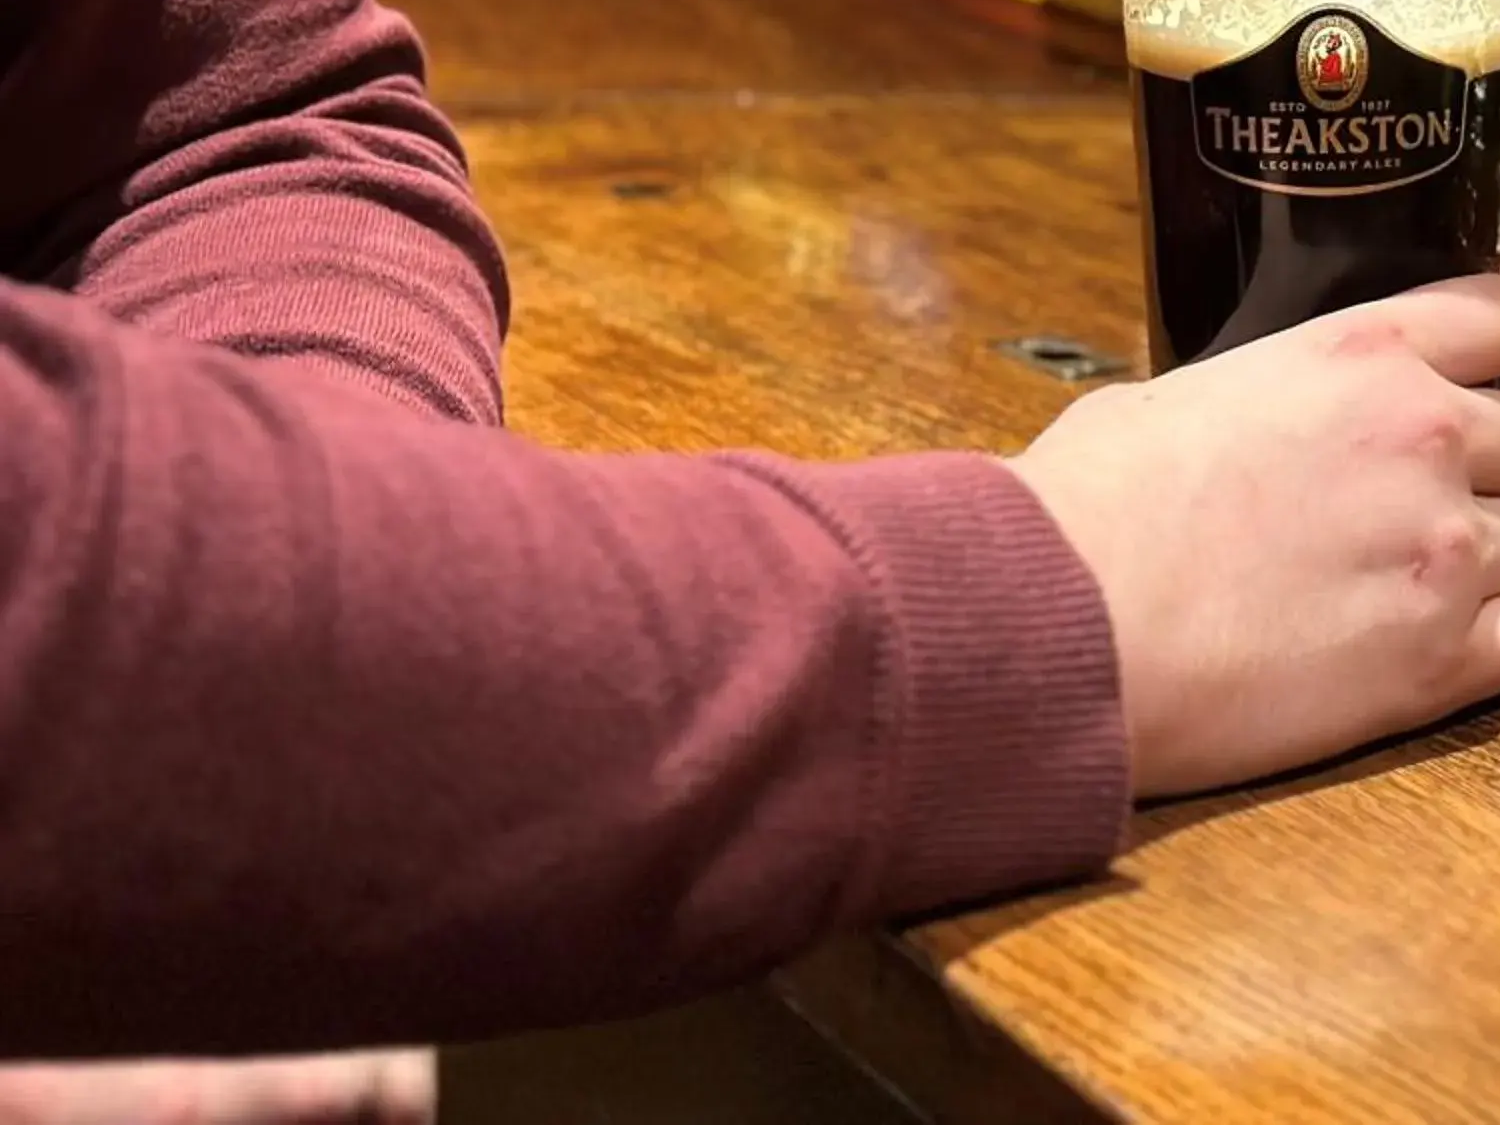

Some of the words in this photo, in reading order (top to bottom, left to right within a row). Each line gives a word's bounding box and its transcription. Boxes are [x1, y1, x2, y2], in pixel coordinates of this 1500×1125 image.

[1204, 106, 1452, 155] THEAKSTON
[1259, 159, 1358, 172] LEGENDARY
[1363, 157, 1402, 170] ALES
